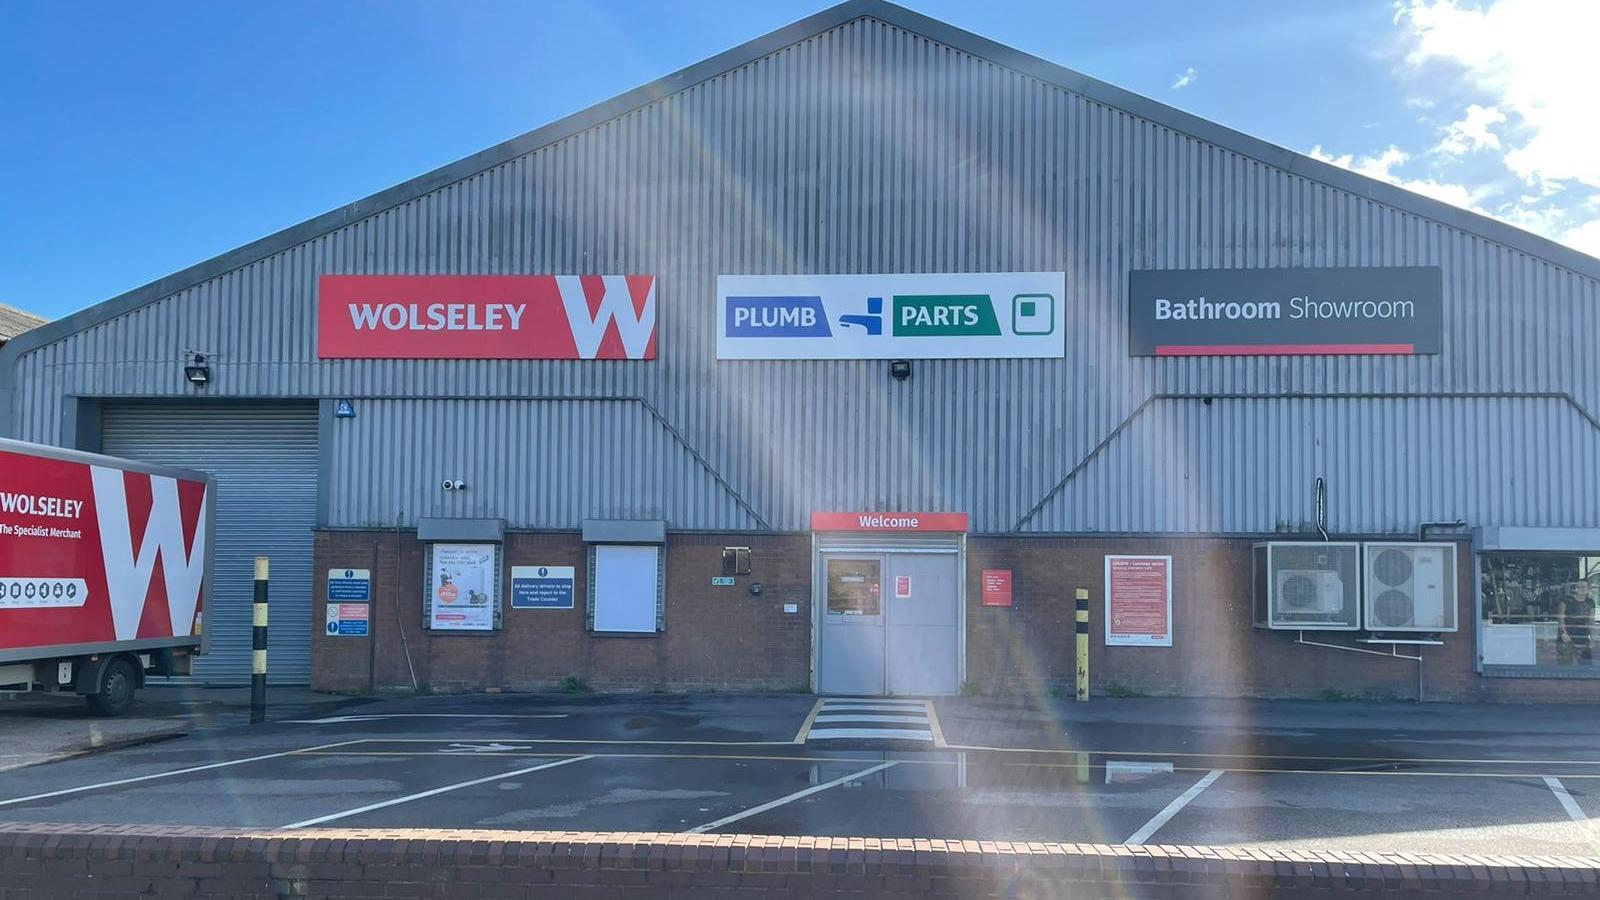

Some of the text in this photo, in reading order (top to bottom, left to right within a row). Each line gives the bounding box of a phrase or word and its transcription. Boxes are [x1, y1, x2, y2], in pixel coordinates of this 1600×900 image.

[348, 303, 527, 331] WOLSELEY
[555, 275, 656, 360] W
[734, 305, 979, 328] PLUMB PARTS
[1155, 296, 1415, 320] Bathroom Showroom
[0, 492, 83, 519] WOLSELEY
[0, 523, 82, 539] The Specialist Merchant
[859, 515, 919, 528] Welcome
